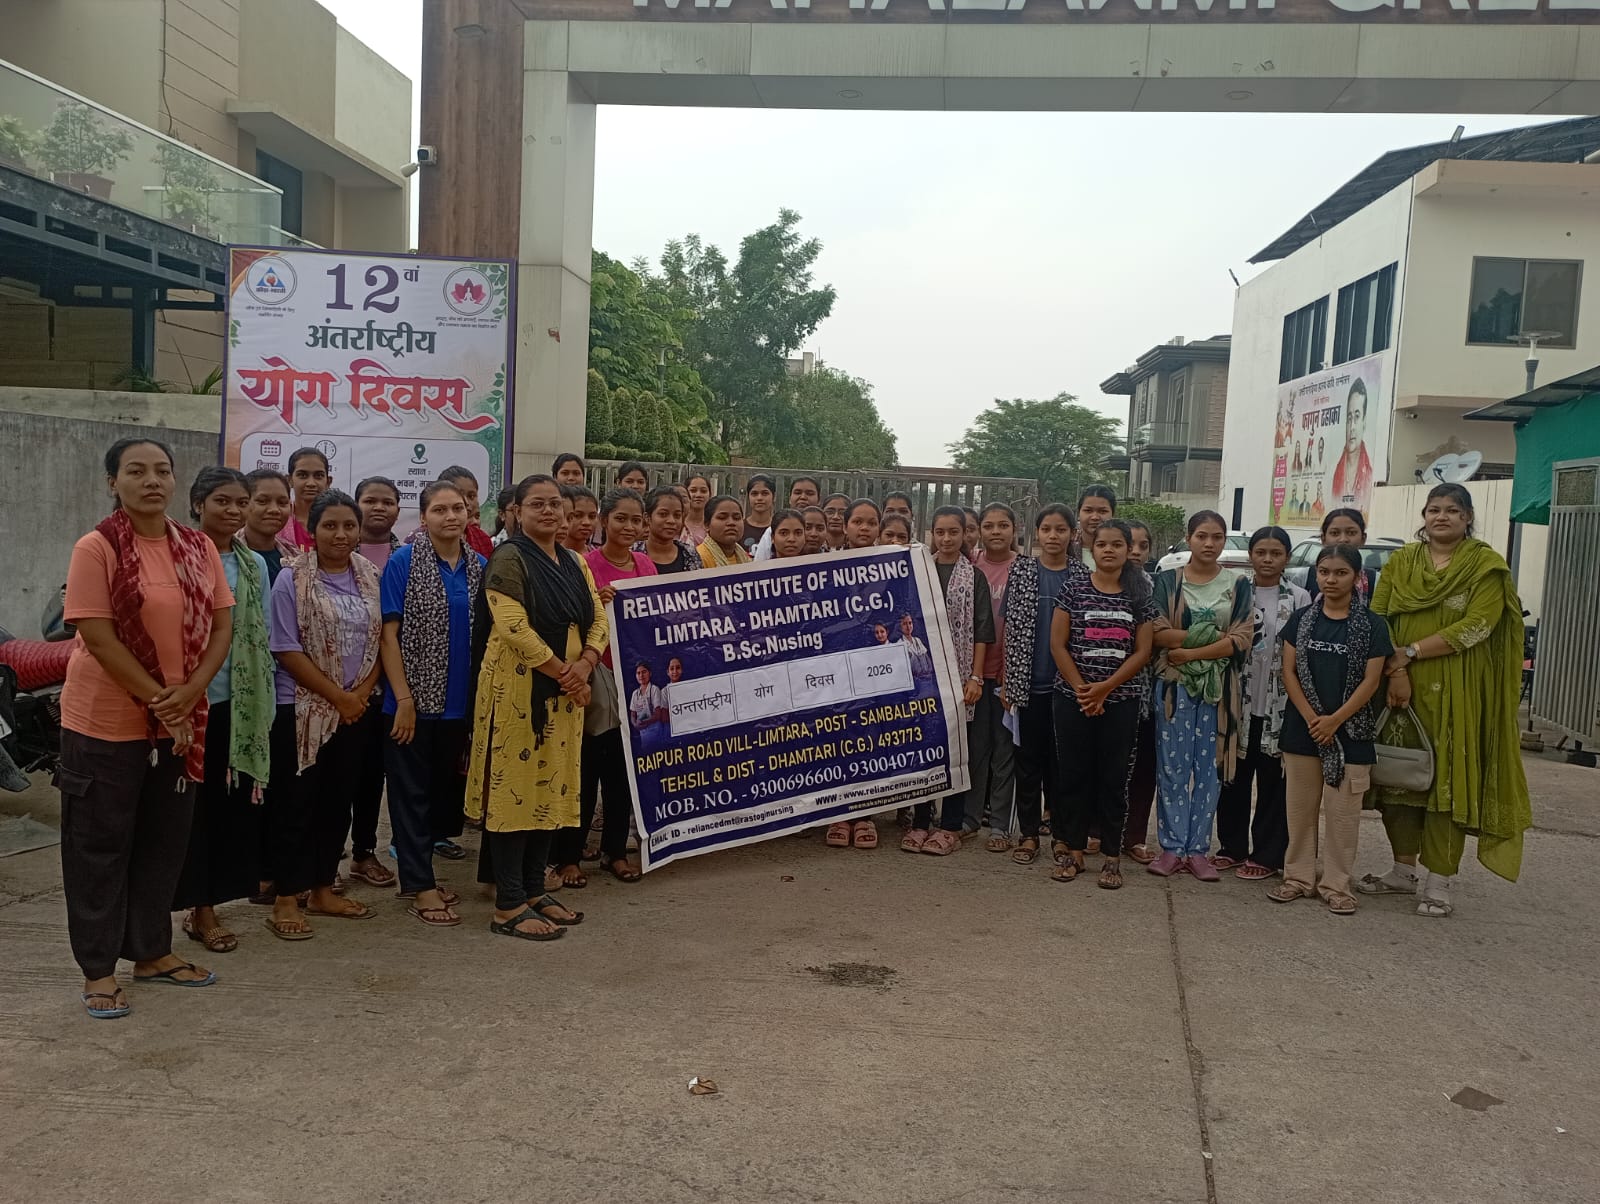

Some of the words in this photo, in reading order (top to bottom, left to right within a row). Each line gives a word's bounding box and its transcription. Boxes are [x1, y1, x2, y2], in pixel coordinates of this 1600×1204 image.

[305, 318, 437, 357] अंतर्राष्ट्रीय
[236, 356, 338, 425] योग
[345, 358, 496, 431] दिवस
[623, 588, 711, 619] RELIANCE
[714, 574, 803, 605] INSTITUTE
[807, 571, 828, 591] OF
[832, 560, 909, 588] NURSING
[654, 615, 736, 646] LIMTARA
[749, 599, 839, 630] DHAMTARI
[845, 590, 894, 618] (C.G.)
[722, 631, 823, 663] B.Sc.Nusing
[671, 691, 732, 717] अन्तर्राष्ट्रीय
[754, 684, 774, 699] योग
[805, 673, 835, 690] दिवस
[867, 663, 893, 677] 2026
[637, 748, 684, 775] RAIPUR
[687, 740, 723, 763] ROAD
[815, 714, 848, 735] POST
[859, 697, 938, 726] SAMBALPUR
[660, 771, 710, 794] TEHSIL
[713, 768, 723, 783] &
[727, 760, 756, 781] DIST
[768, 742, 837, 771] DHAMTARI
[840, 735, 874, 758] (C.G.)
[878, 726, 923, 748] 493773
[655, 797, 700, 822] MOB.
[703, 789, 738, 809] NO.
[750, 765, 847, 800] 9300696600,
[849, 745, 945, 778] 9300407100
[843, 772, 946, 800] www.reliancenursing.com
[671, 829, 681, 838] ID
